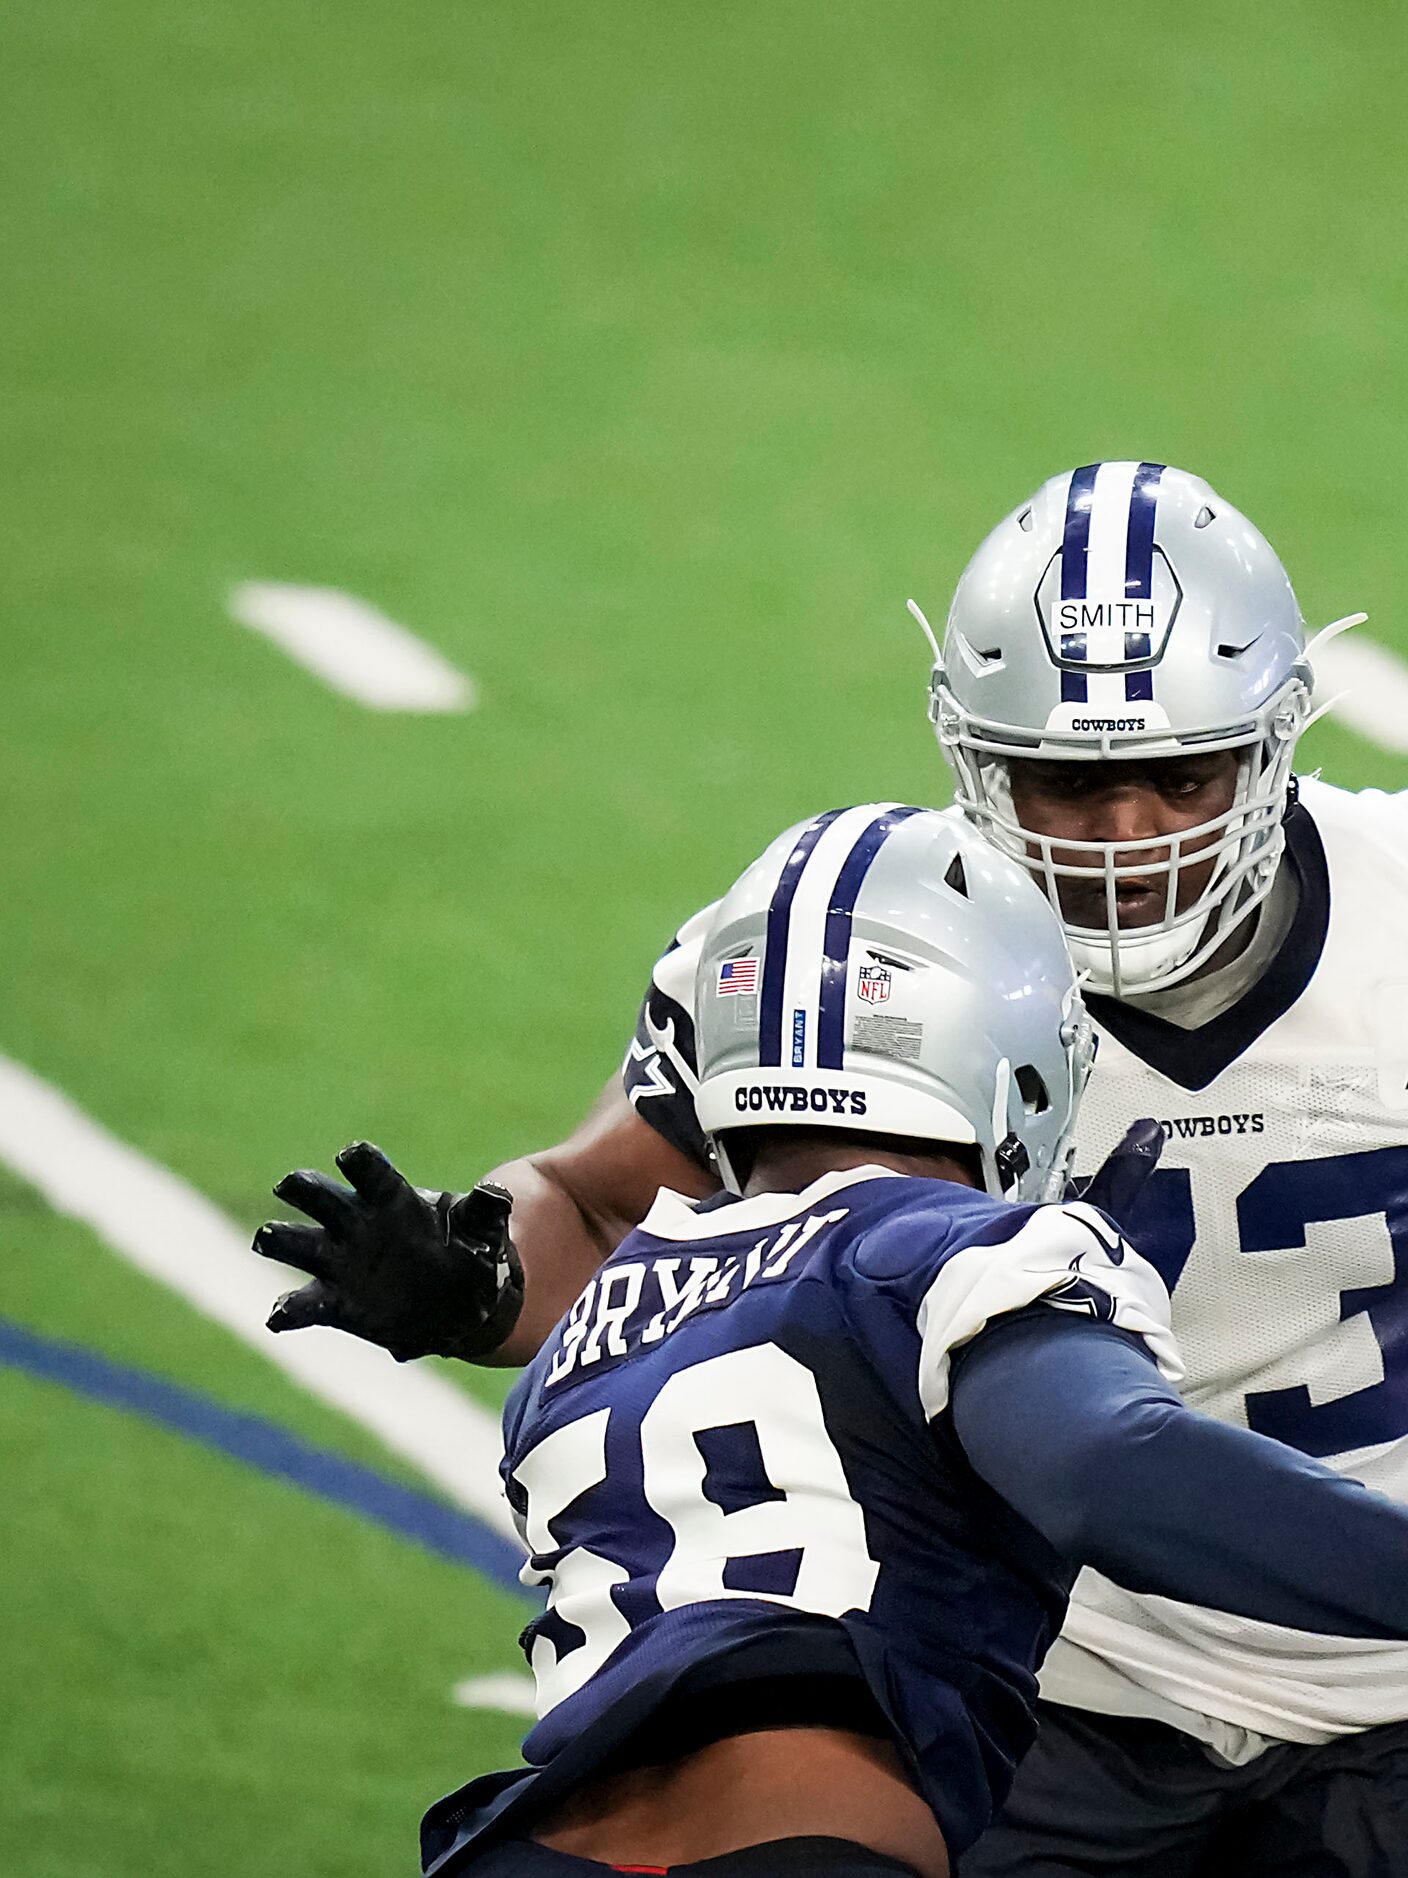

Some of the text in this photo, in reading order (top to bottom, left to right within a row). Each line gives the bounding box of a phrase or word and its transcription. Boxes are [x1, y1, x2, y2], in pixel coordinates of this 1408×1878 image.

[1060, 604, 1154, 629] SMITH
[1071, 718, 1146, 732] COWBOYS
[861, 980, 888, 1001] NFL
[793, 1011, 804, 1064] BRYANT
[735, 1086, 867, 1115] COWBOYS
[1159, 1113, 1264, 1139] OWBOYS
[511, 1341, 881, 1721] 58
